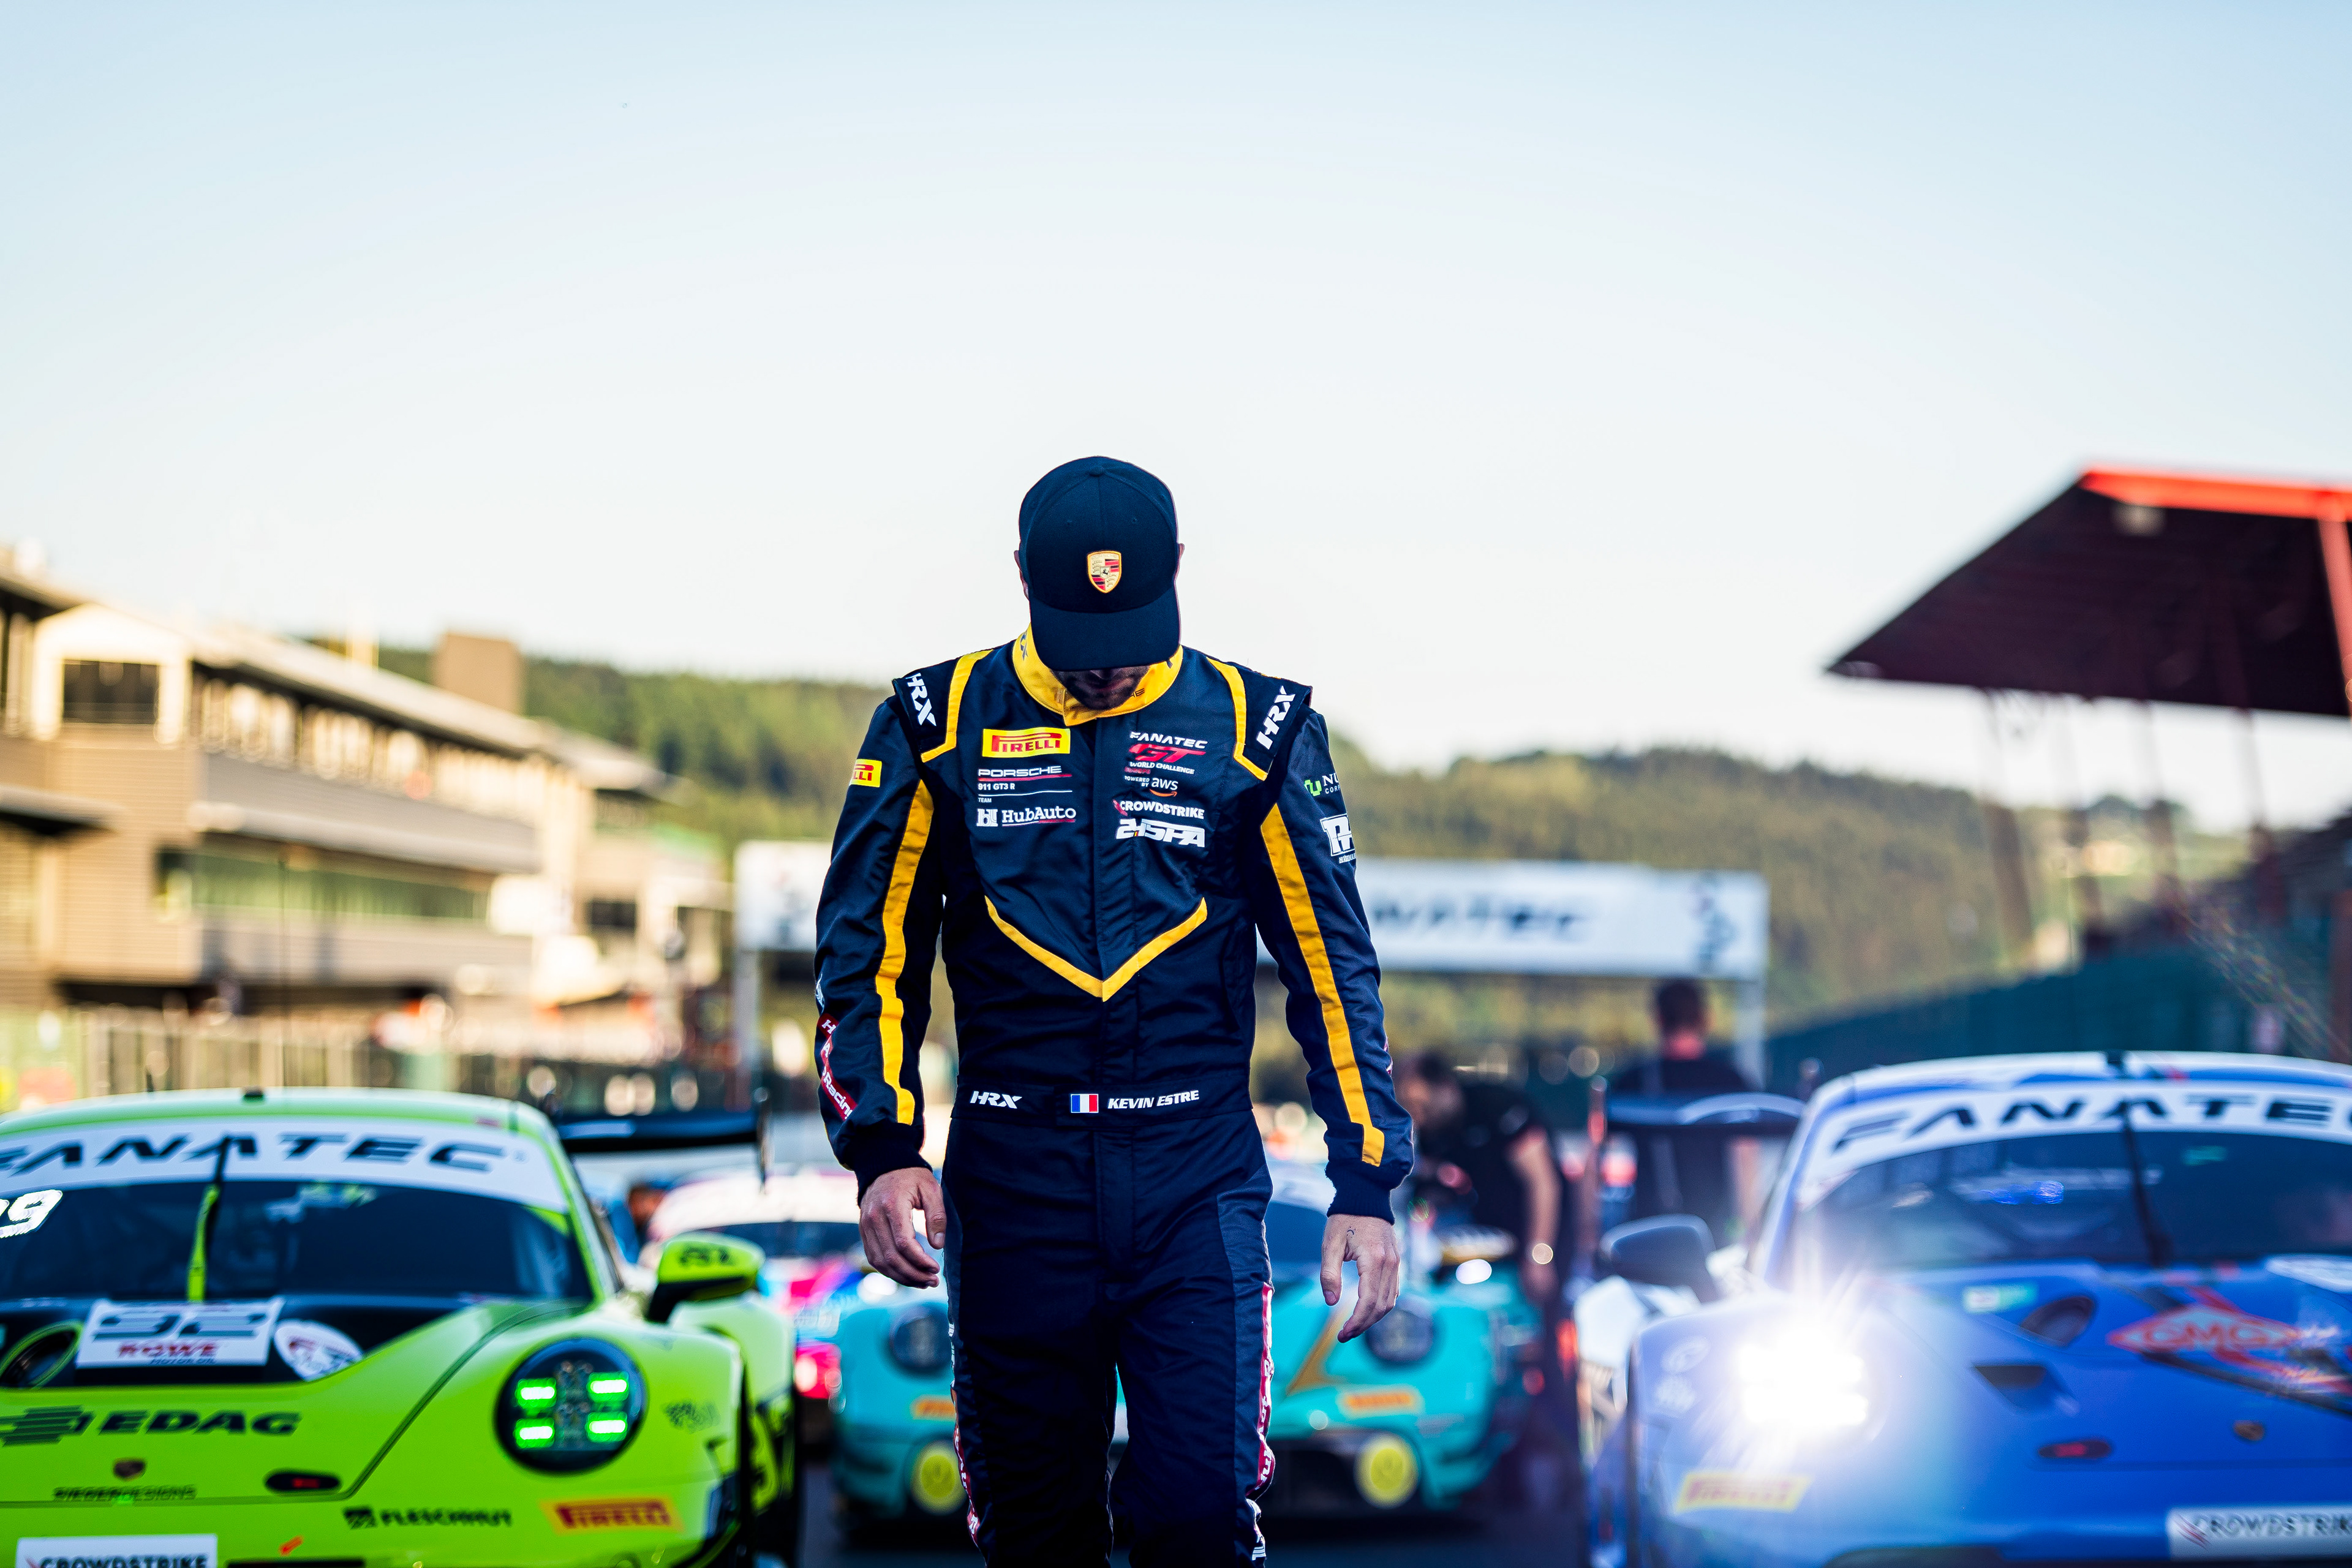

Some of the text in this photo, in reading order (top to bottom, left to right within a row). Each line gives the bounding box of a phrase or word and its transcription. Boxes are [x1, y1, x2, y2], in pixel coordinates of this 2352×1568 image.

[905, 673, 937, 726] HRX
[1257, 685, 1295, 750] HRX
[991, 732, 1062, 753] PIRELLI
[1129, 731, 1208, 749] FANATEC
[1129, 744, 1207, 763] GT
[978, 766, 1062, 777] PORSCHE
[1156, 763, 1195, 775] CHALLENGE
[1152, 777, 1178, 791] aws
[1001, 806, 1077, 823] HubAuto
[1120, 801, 1205, 820] CROWDSTRIKE
[970, 1090, 1022, 1109] HRX
[1107, 1090, 1199, 1109] KEVIN ESTRE
[1831, 1096, 2352, 1153] FANATE
[0, 1189, 62, 1238] 9
[98, 1409, 302, 1436] EDAG
[556, 1501, 671, 1529] PIRELLI
[2193, 1512, 2352, 1538] CROWDSTRIK
